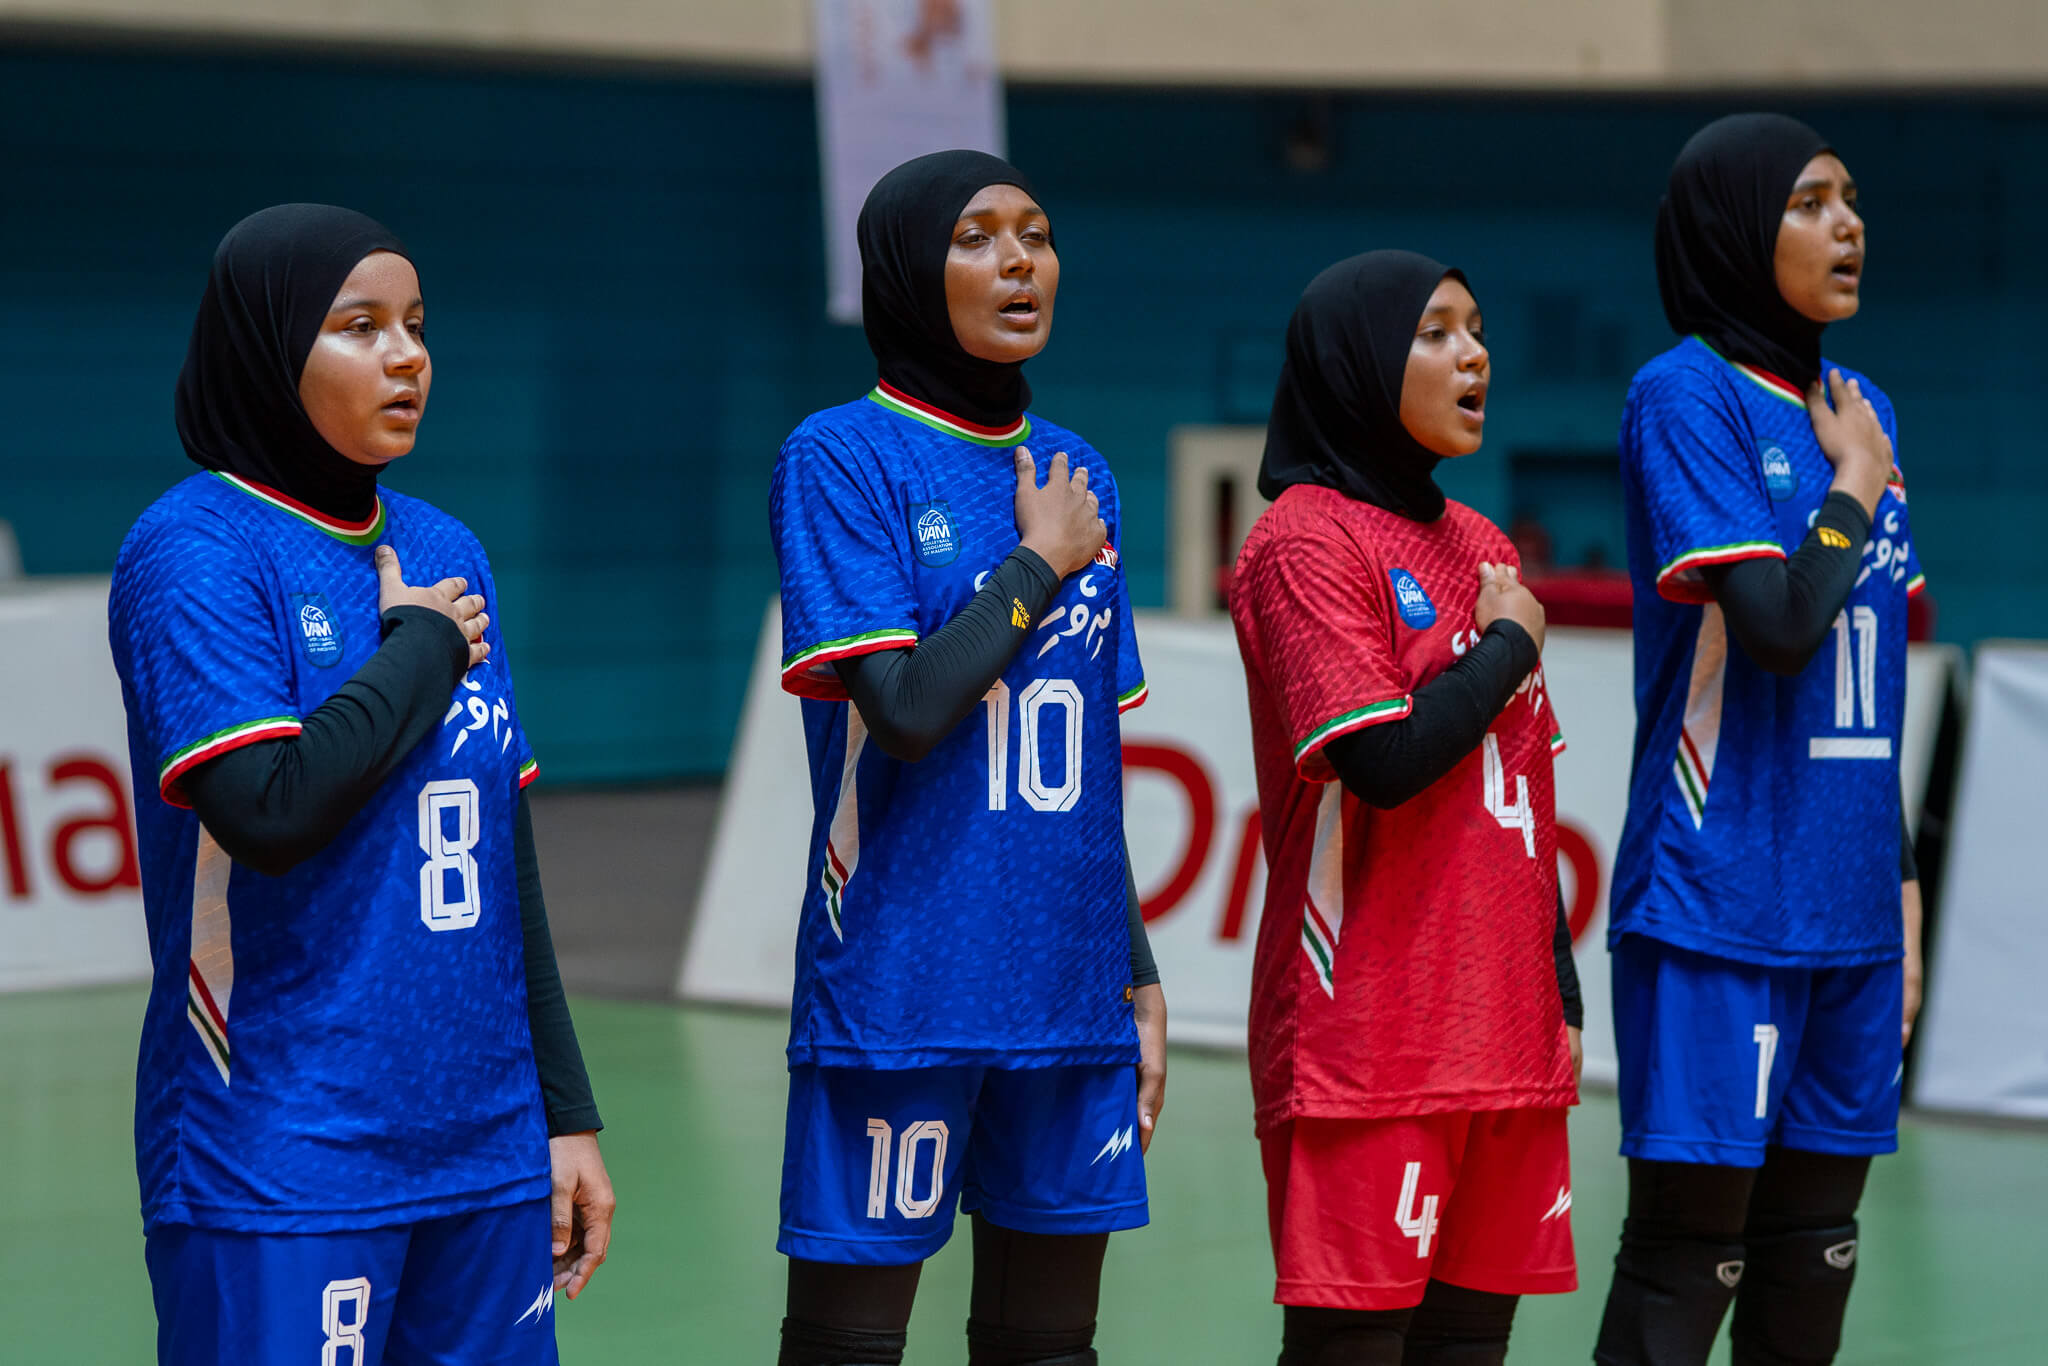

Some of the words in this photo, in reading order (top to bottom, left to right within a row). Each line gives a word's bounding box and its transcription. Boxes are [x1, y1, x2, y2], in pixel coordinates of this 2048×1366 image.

[918, 524, 951, 543] VAM
[302, 619, 333, 638] VAM
[1399, 589, 1426, 606] VAM
[981, 678, 1084, 812] 10
[1482, 732, 1537, 859] 4
[418, 778, 481, 932] 8
[866, 1117, 950, 1220] 10
[1393, 1161, 1439, 1259] 4
[321, 1276, 371, 1366] 8
